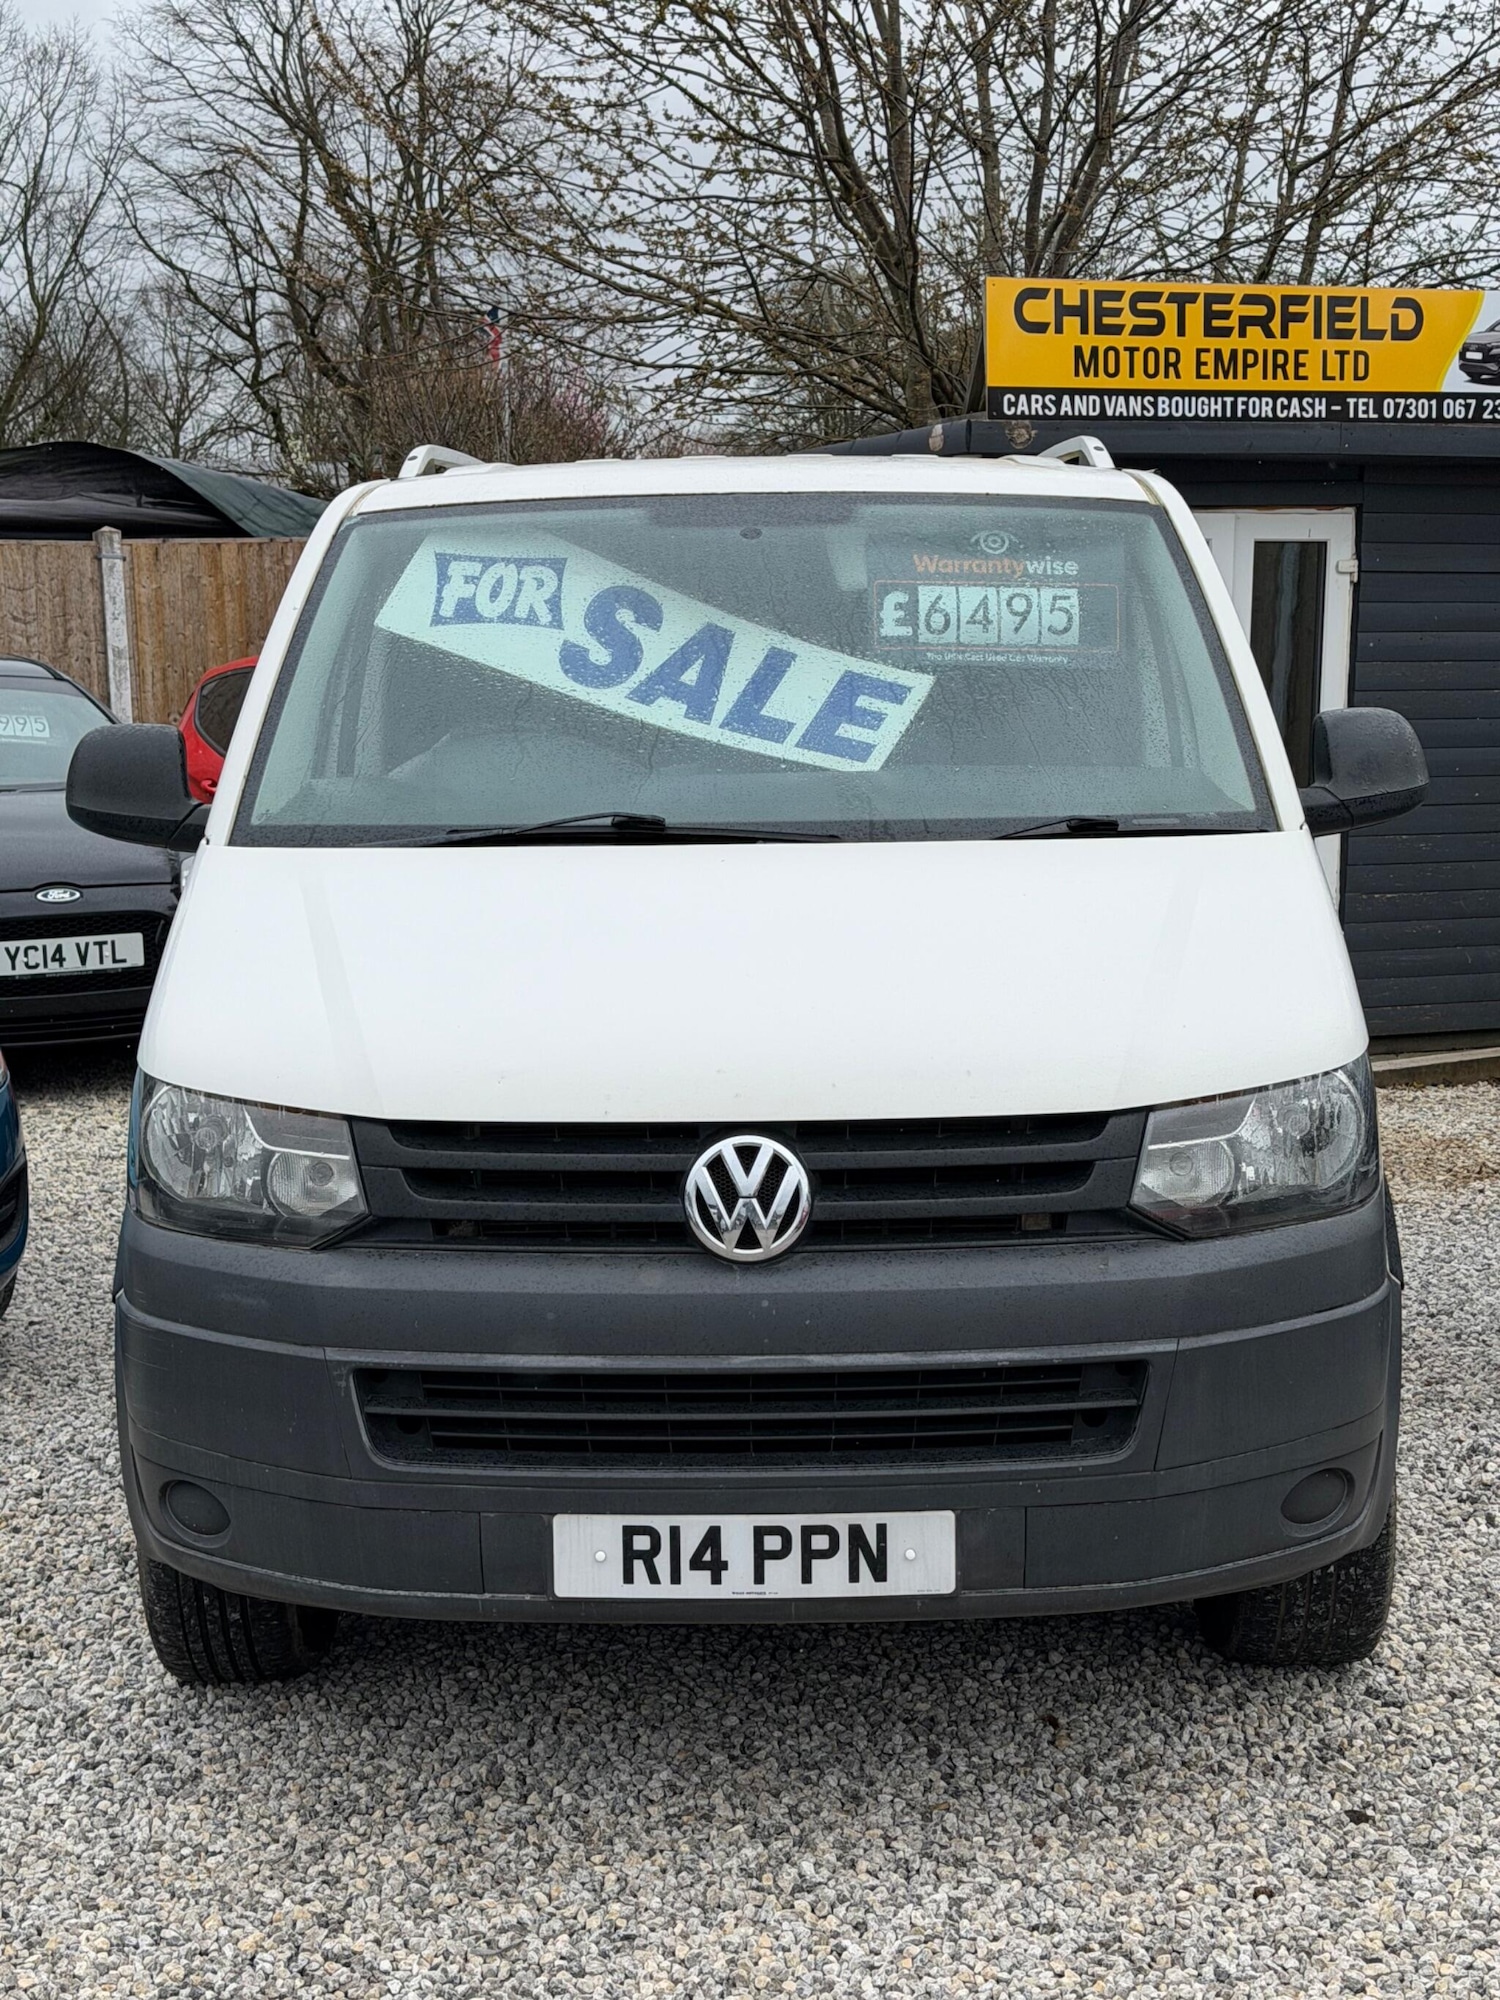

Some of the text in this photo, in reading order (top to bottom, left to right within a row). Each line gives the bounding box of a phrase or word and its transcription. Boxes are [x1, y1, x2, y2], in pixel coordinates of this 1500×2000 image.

[1014, 287, 1424, 341] CHESTERFIELD
[1074, 345, 1370, 381] MOTOR EMPIRE LTD
[1003, 393, 1056, 416] CARS
[1059, 394, 1100, 416] AND
[1103, 395, 1155, 417] VANS
[1157, 396, 1235, 418] BOUGHT
[1236, 397, 1273, 418] FOR
[1276, 397, 1326, 419] CASH
[1346, 398, 1379, 419] TEL
[1382, 398, 1437, 419] 07301
[1442, 399, 1477, 419] 067
[912, 554, 1079, 579] Warrantywise
[437, 560, 562, 624] FOR
[879, 590, 1075, 637] £6495
[559, 585, 913, 763] SALE
[4, 939, 127, 971] YC14 VTL
[622, 1522, 888, 1585] R14 PPN
